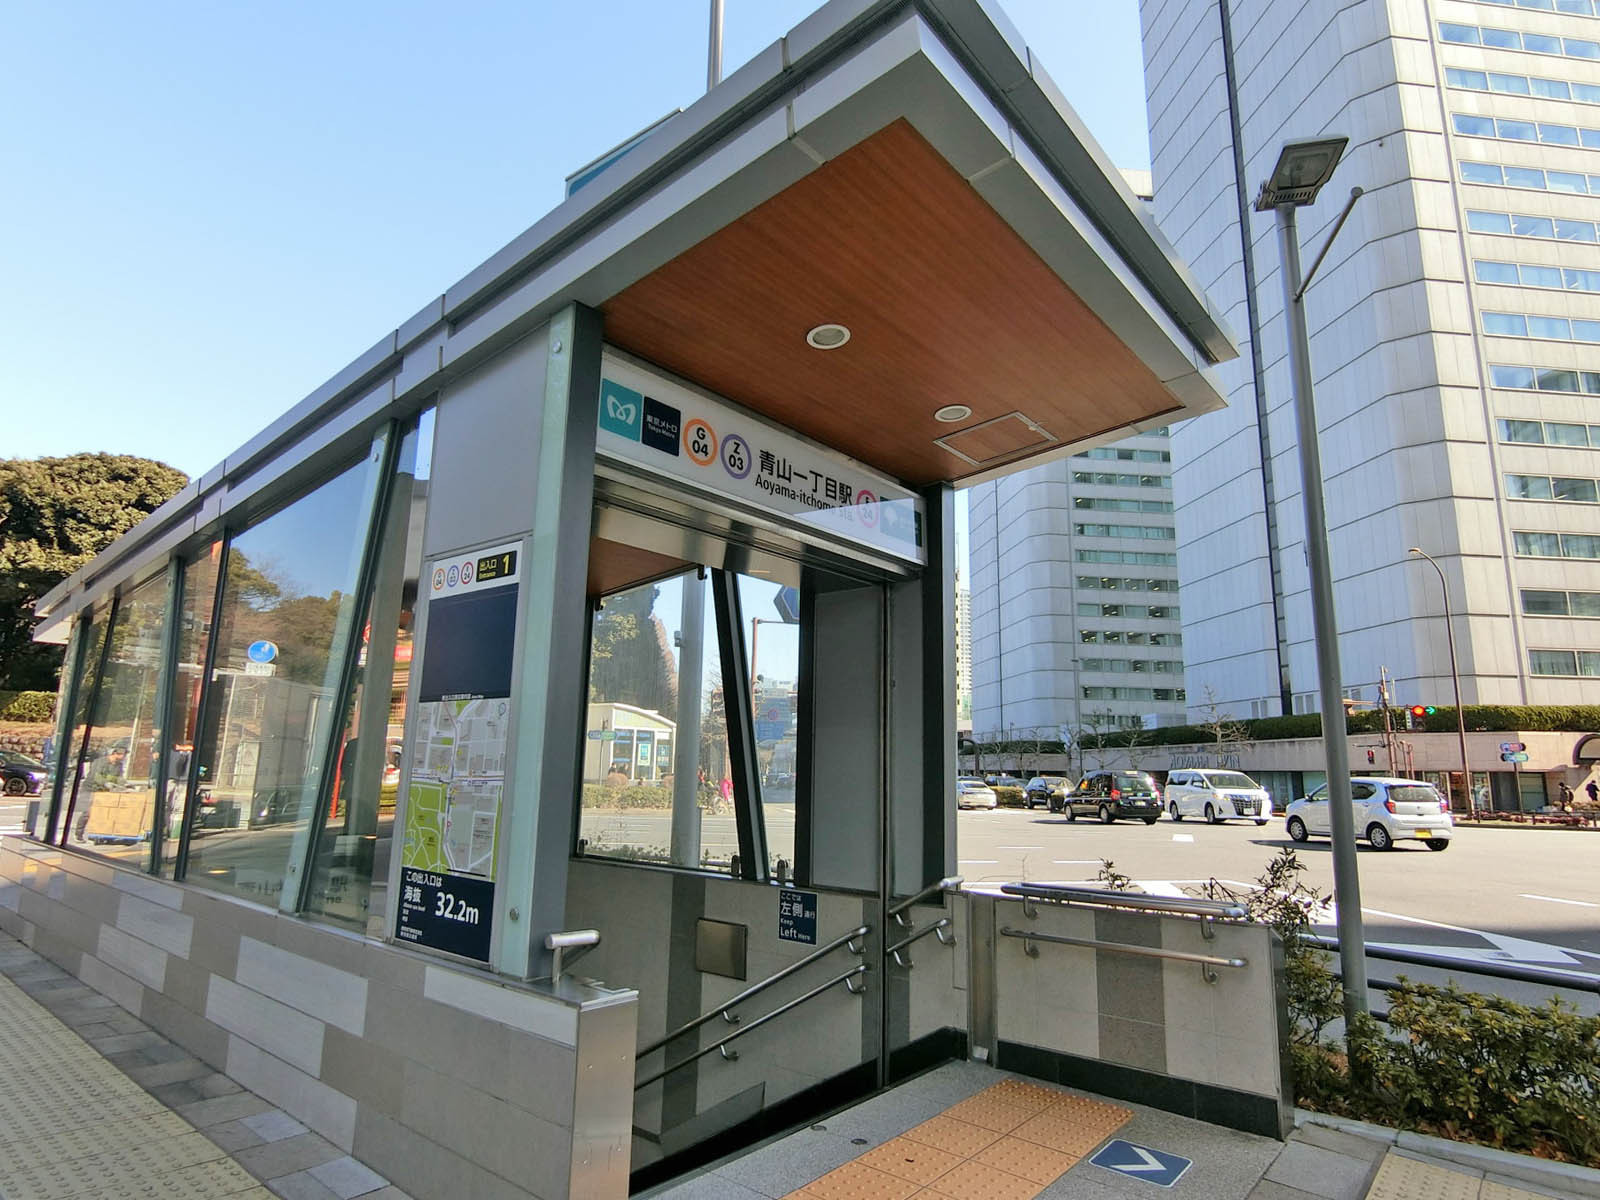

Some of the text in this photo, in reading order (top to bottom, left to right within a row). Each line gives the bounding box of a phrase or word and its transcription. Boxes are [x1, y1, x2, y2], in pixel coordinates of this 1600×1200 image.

[696, 427, 706, 440] G
[692, 440, 709, 457] 04
[733, 442, 741, 455] Z
[728, 454, 744, 471] 03
[759, 449, 853, 506] 青山一丁目駅
[503, 554, 510, 575] 1
[406, 871, 443, 887] この出入口は
[435, 891, 479, 925] 32.2m
[780, 918, 794, 926] Keep
[780, 926, 797, 939] Left
